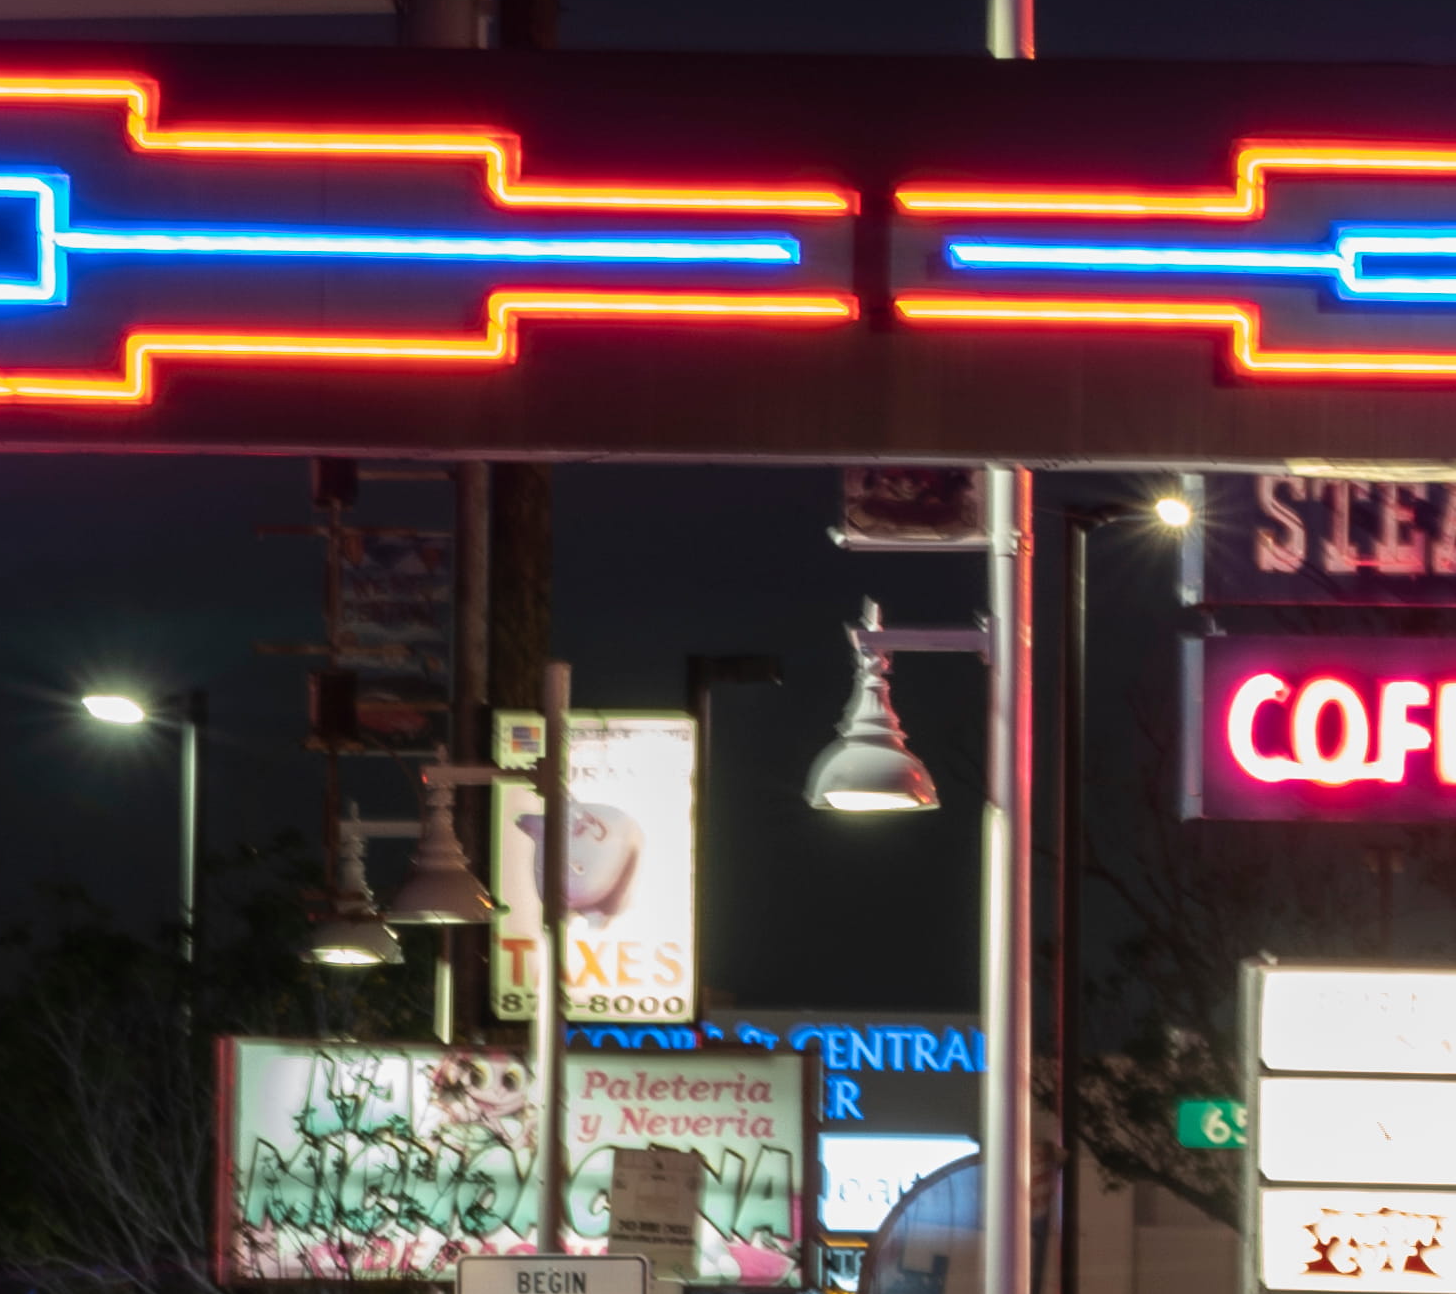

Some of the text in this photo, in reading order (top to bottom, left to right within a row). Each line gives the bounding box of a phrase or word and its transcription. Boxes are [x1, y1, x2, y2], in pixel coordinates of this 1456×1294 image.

[1256, 474, 1456, 573] STE
[500, 938, 685, 988] TXES
[501, 993, 686, 1016] 8-8000
[582, 1069, 773, 1104] Paleteria
[577, 1106, 776, 1144] y Neveria
